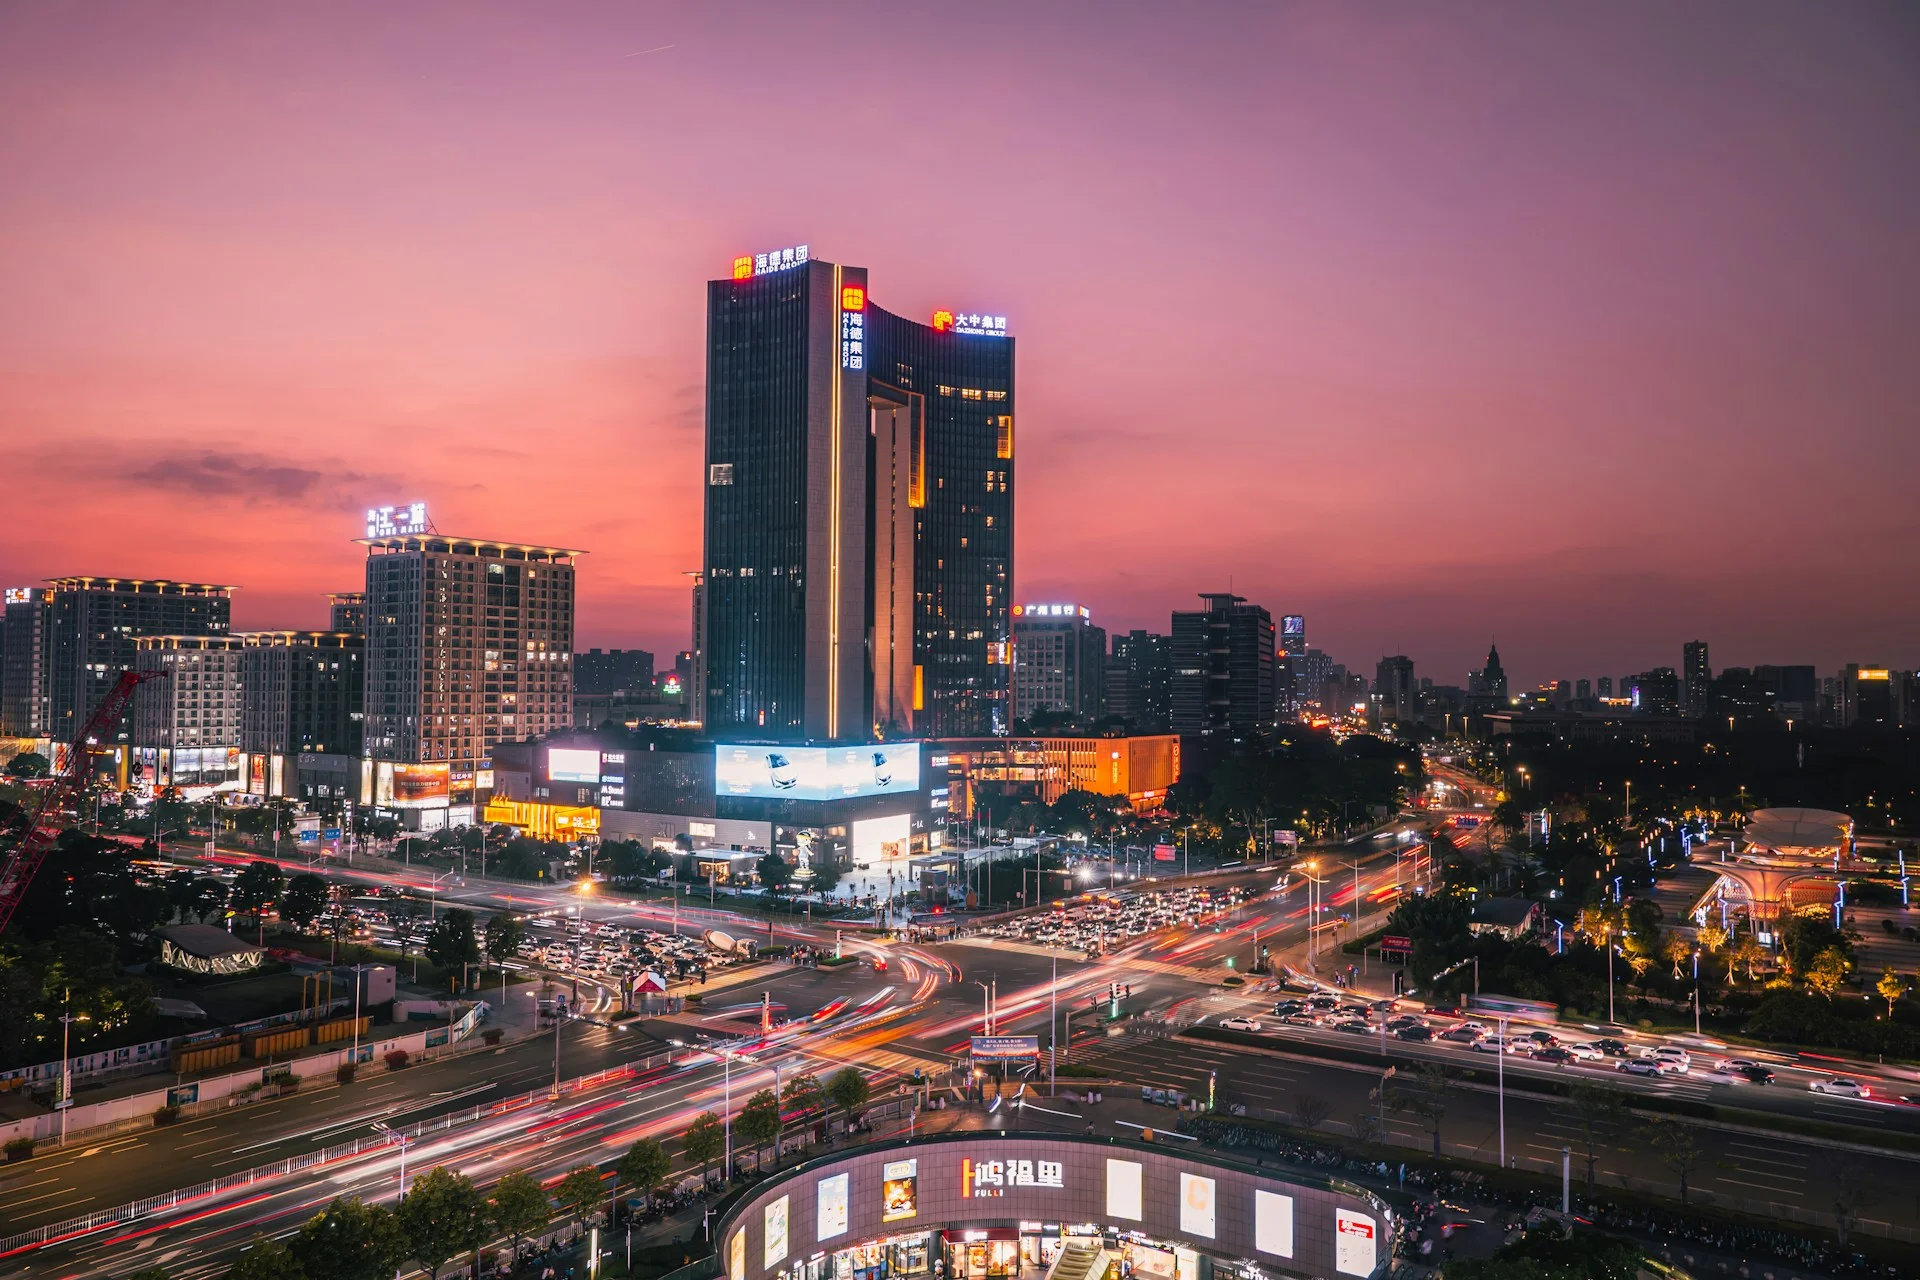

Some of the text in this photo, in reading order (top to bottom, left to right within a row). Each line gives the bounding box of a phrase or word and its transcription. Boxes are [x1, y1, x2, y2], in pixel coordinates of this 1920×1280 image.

[955, 313, 1006, 330] 大中集团
[850, 312, 863, 369] 海德集团
[1025, 604, 1075, 616] 广州银行
[974, 1188, 1004, 1198] FULLI
